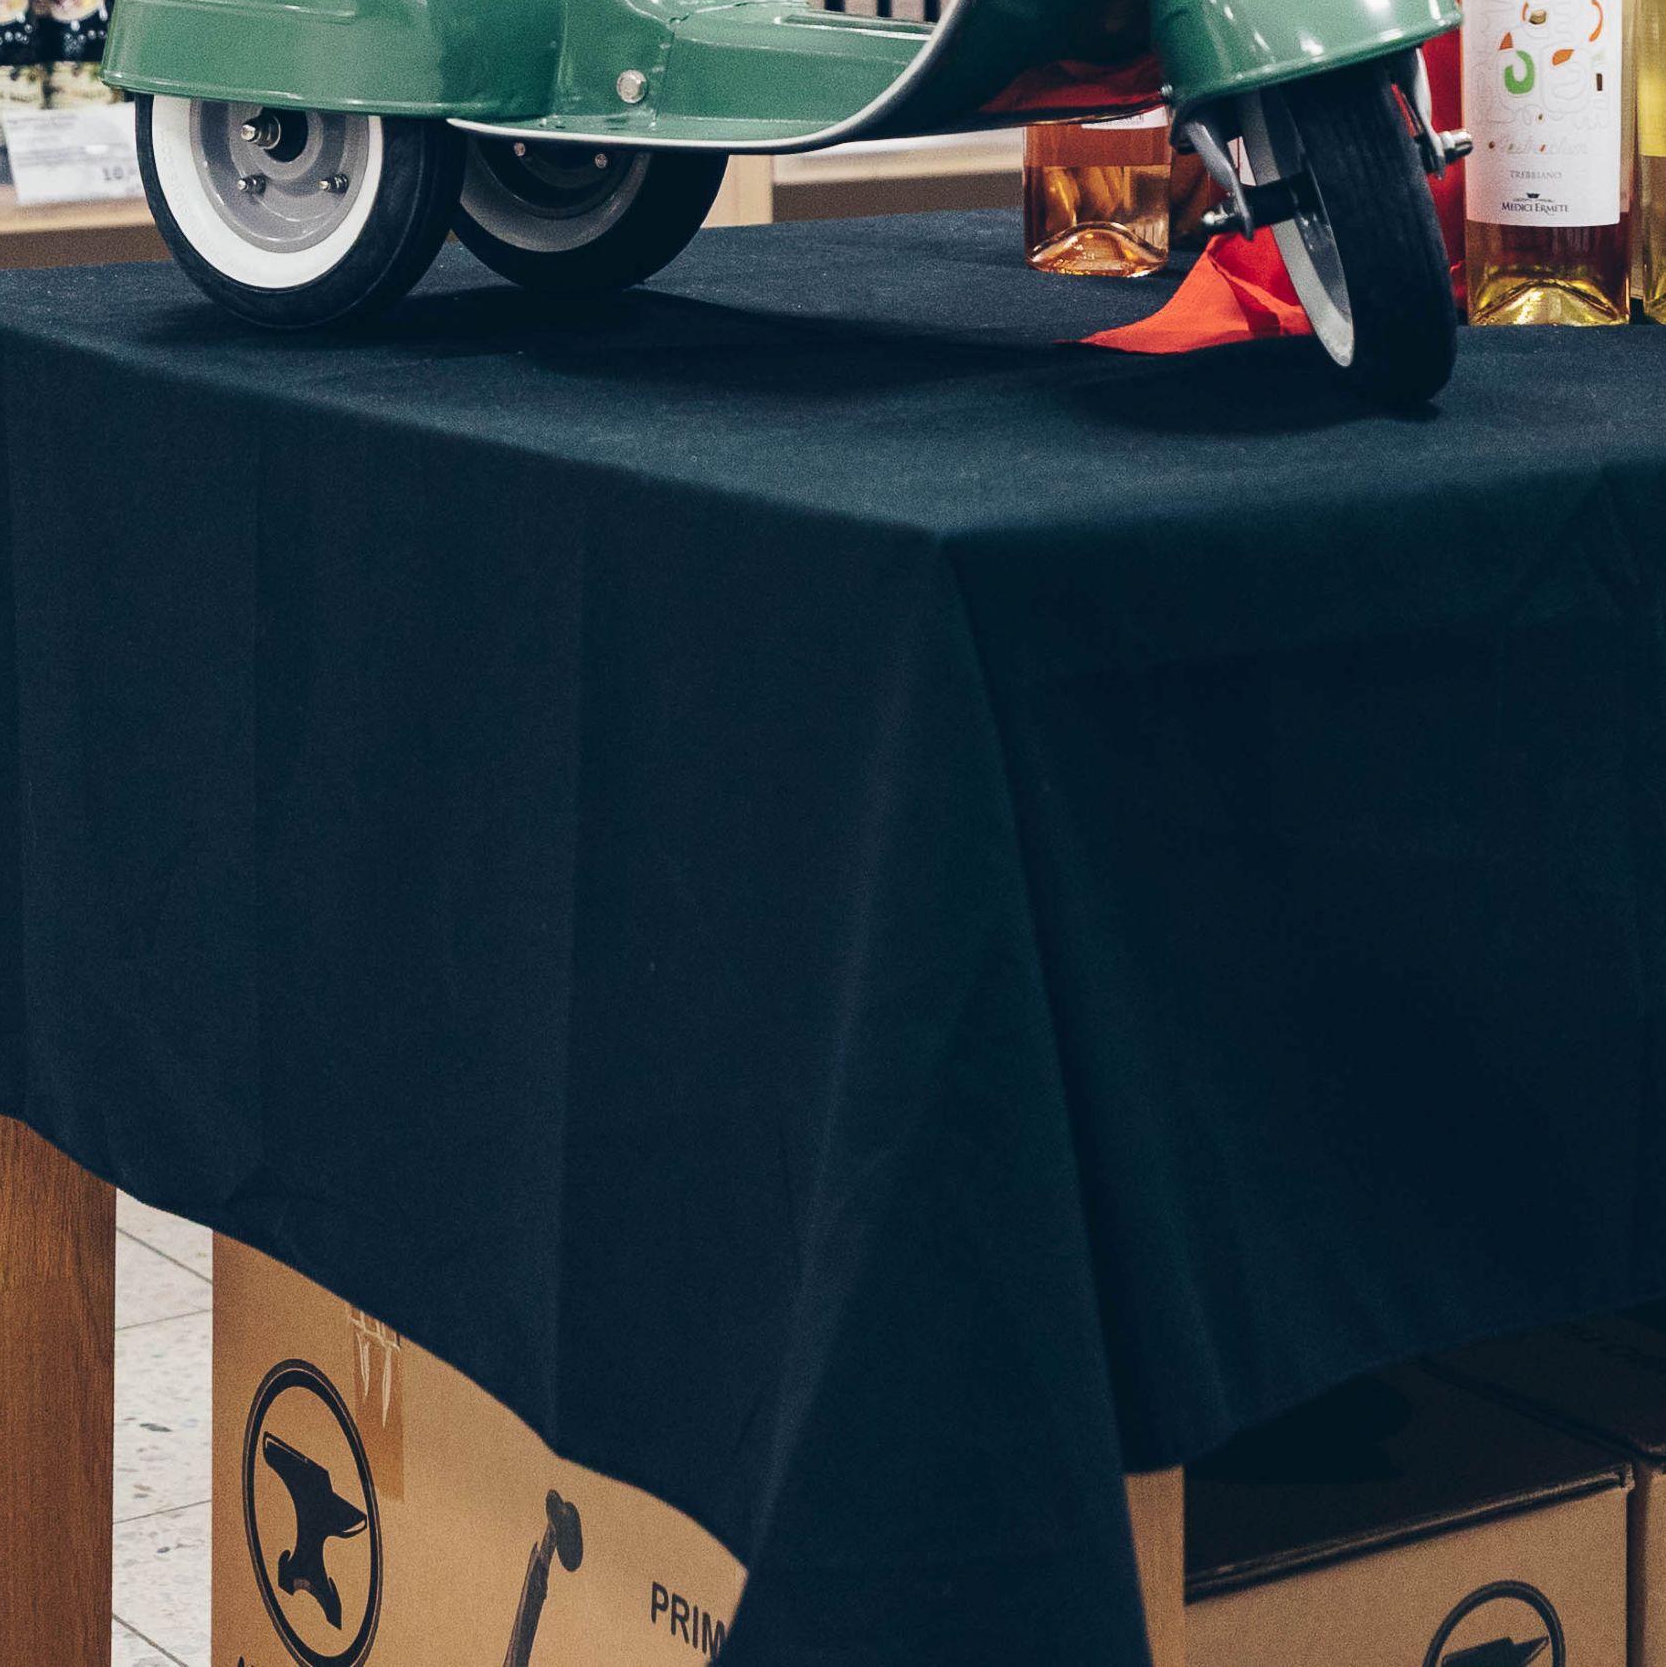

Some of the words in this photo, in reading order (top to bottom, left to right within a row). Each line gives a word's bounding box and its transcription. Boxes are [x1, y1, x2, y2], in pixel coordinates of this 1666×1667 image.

[1509, 169, 1563, 180] TREBBIANO
[1501, 201, 1534, 213] MEDICI
[1534, 201, 1570, 215] ERMETE
[650, 1580, 729, 1662] PRIM
